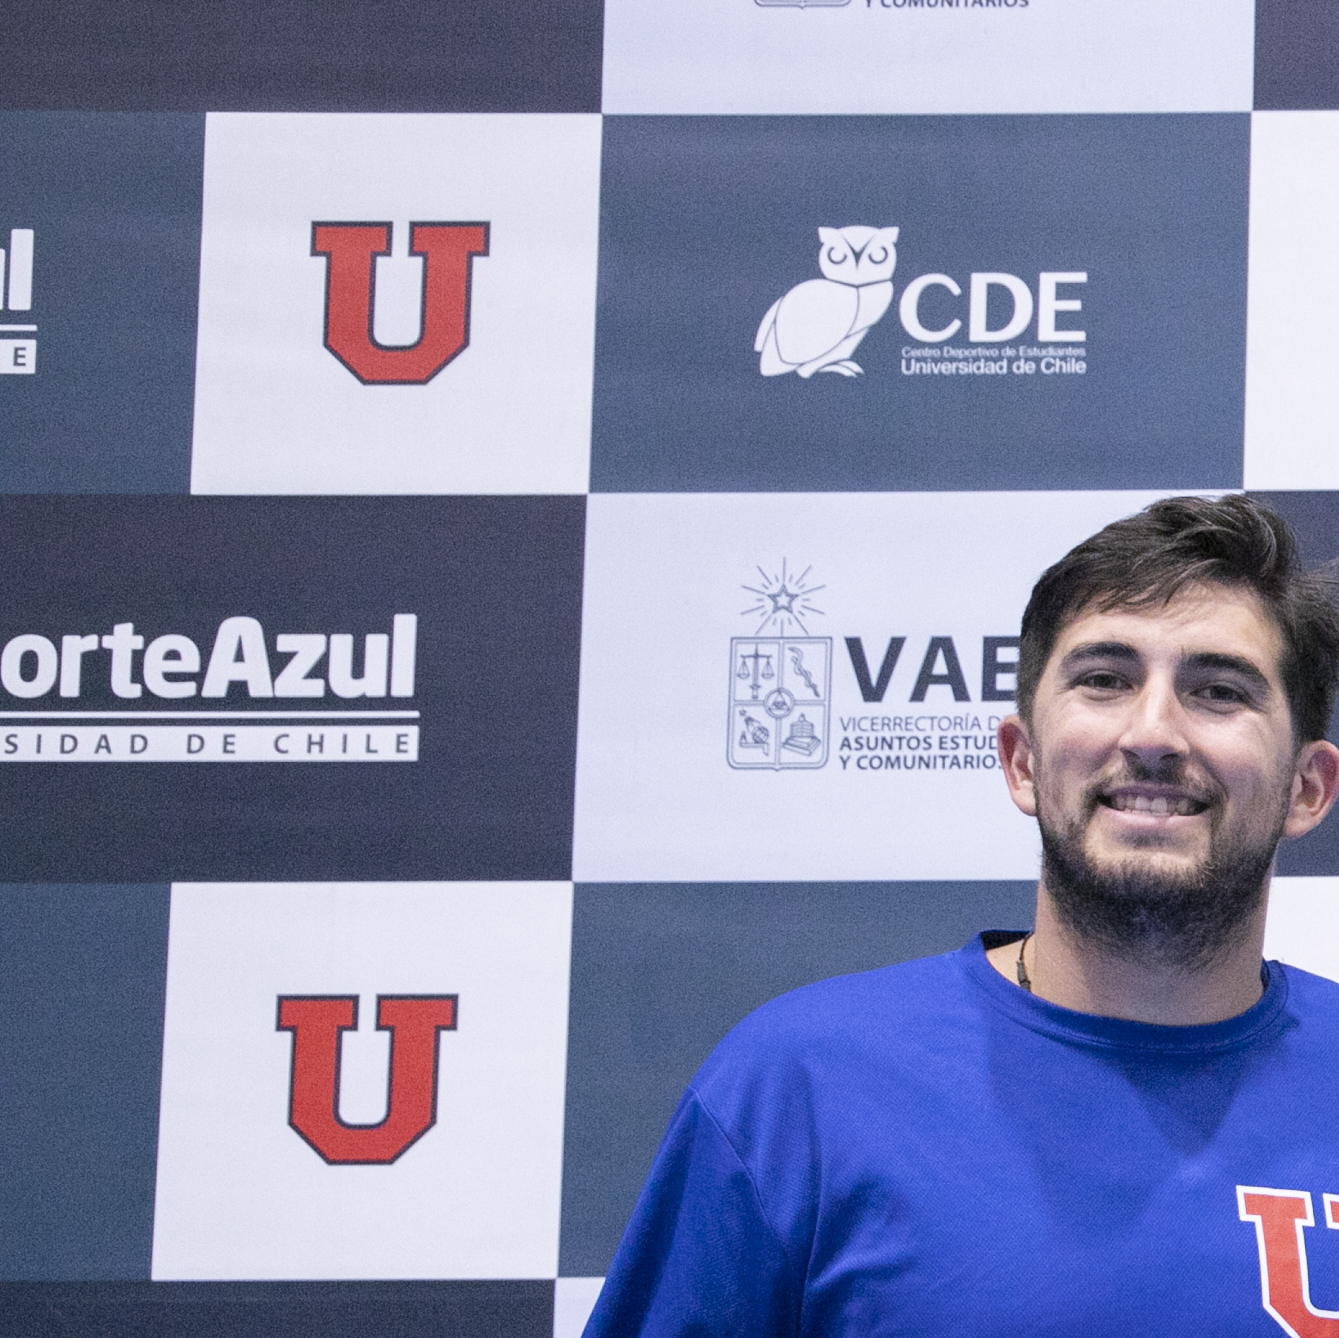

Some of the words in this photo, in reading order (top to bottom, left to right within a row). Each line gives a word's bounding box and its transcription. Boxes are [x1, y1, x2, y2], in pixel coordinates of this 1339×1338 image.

[310, 220, 490, 385] U
[900, 272, 1087, 342] CDE
[902, 346, 941, 358] Centro
[943, 346, 999, 360] Deportivo
[1001, 346, 1016, 357] de
[1019, 345, 1086, 357] Estudiantes
[901, 358, 1007, 375] Universidad
[1012, 358, 1036, 374] de
[1041, 357, 1087, 374] Chile
[0, 613, 418, 699] orteAzul
[844, 636, 1020, 703] VAE
[840, 713, 982, 732] VICERRECTORÍA
[988, 715, 1001, 731] D
[186, 733, 237, 755] DE
[273, 732, 409, 755] CHILE
[840, 735, 932, 751] ASUNTOS
[839, 755, 851, 770] Y
[857, 754, 1002, 770] COMUNITARIO
[275, 993, 458, 1166] U
